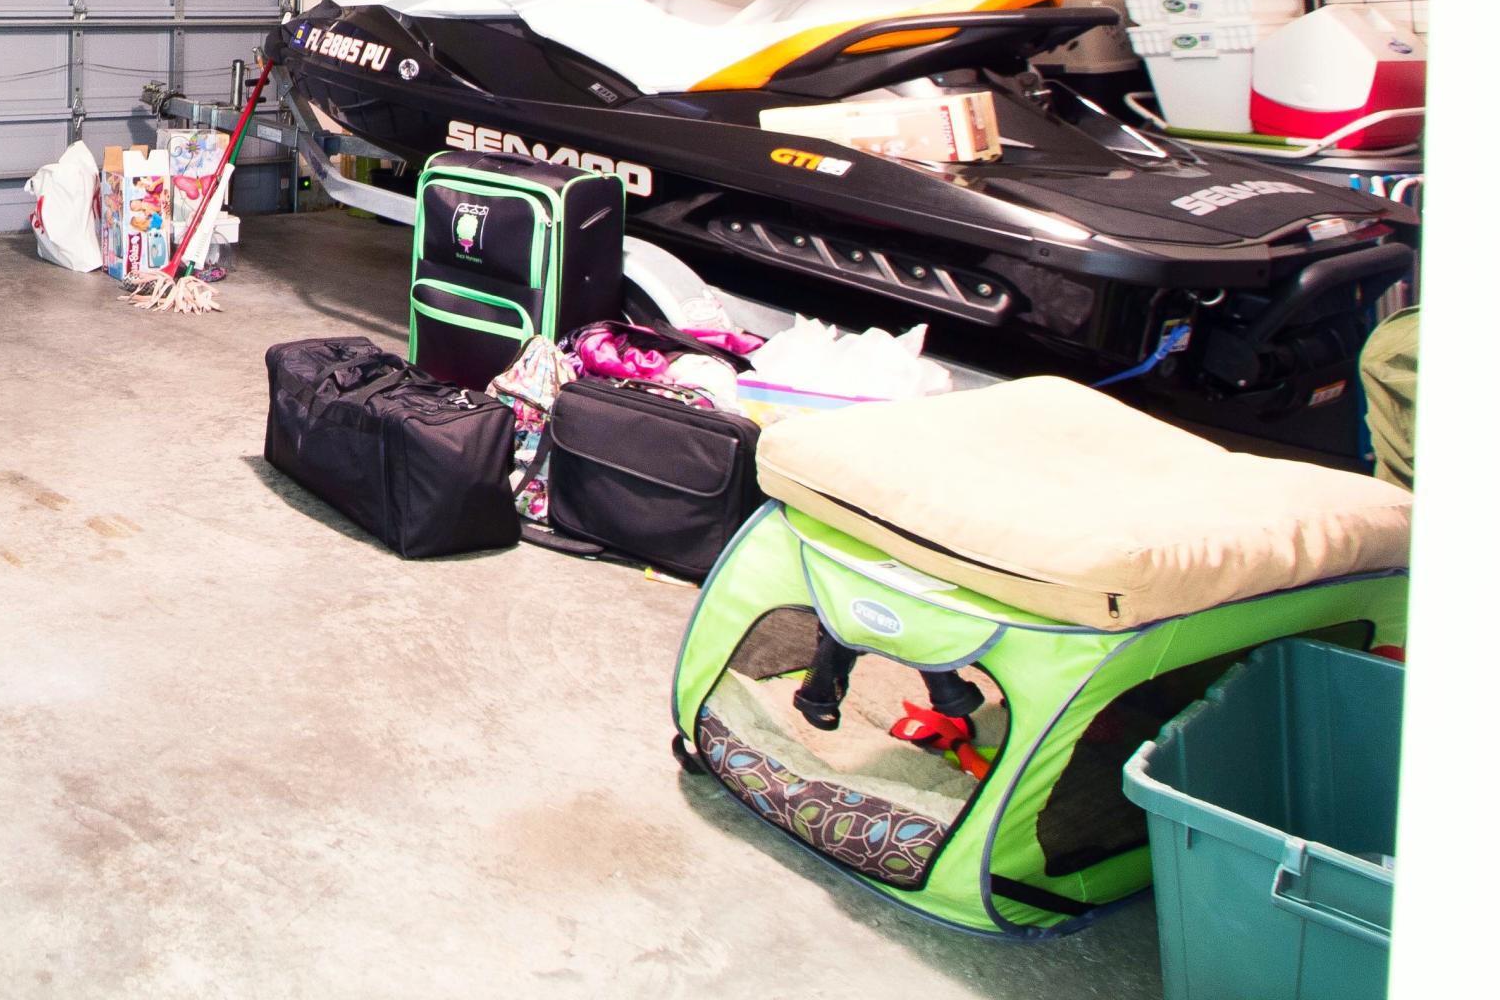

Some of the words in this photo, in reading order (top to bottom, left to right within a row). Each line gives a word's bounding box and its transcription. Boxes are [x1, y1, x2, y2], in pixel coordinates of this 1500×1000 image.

[305, 28, 322, 52] FL
[320, 32, 364, 63] 2885
[360, 42, 391, 71] PU
